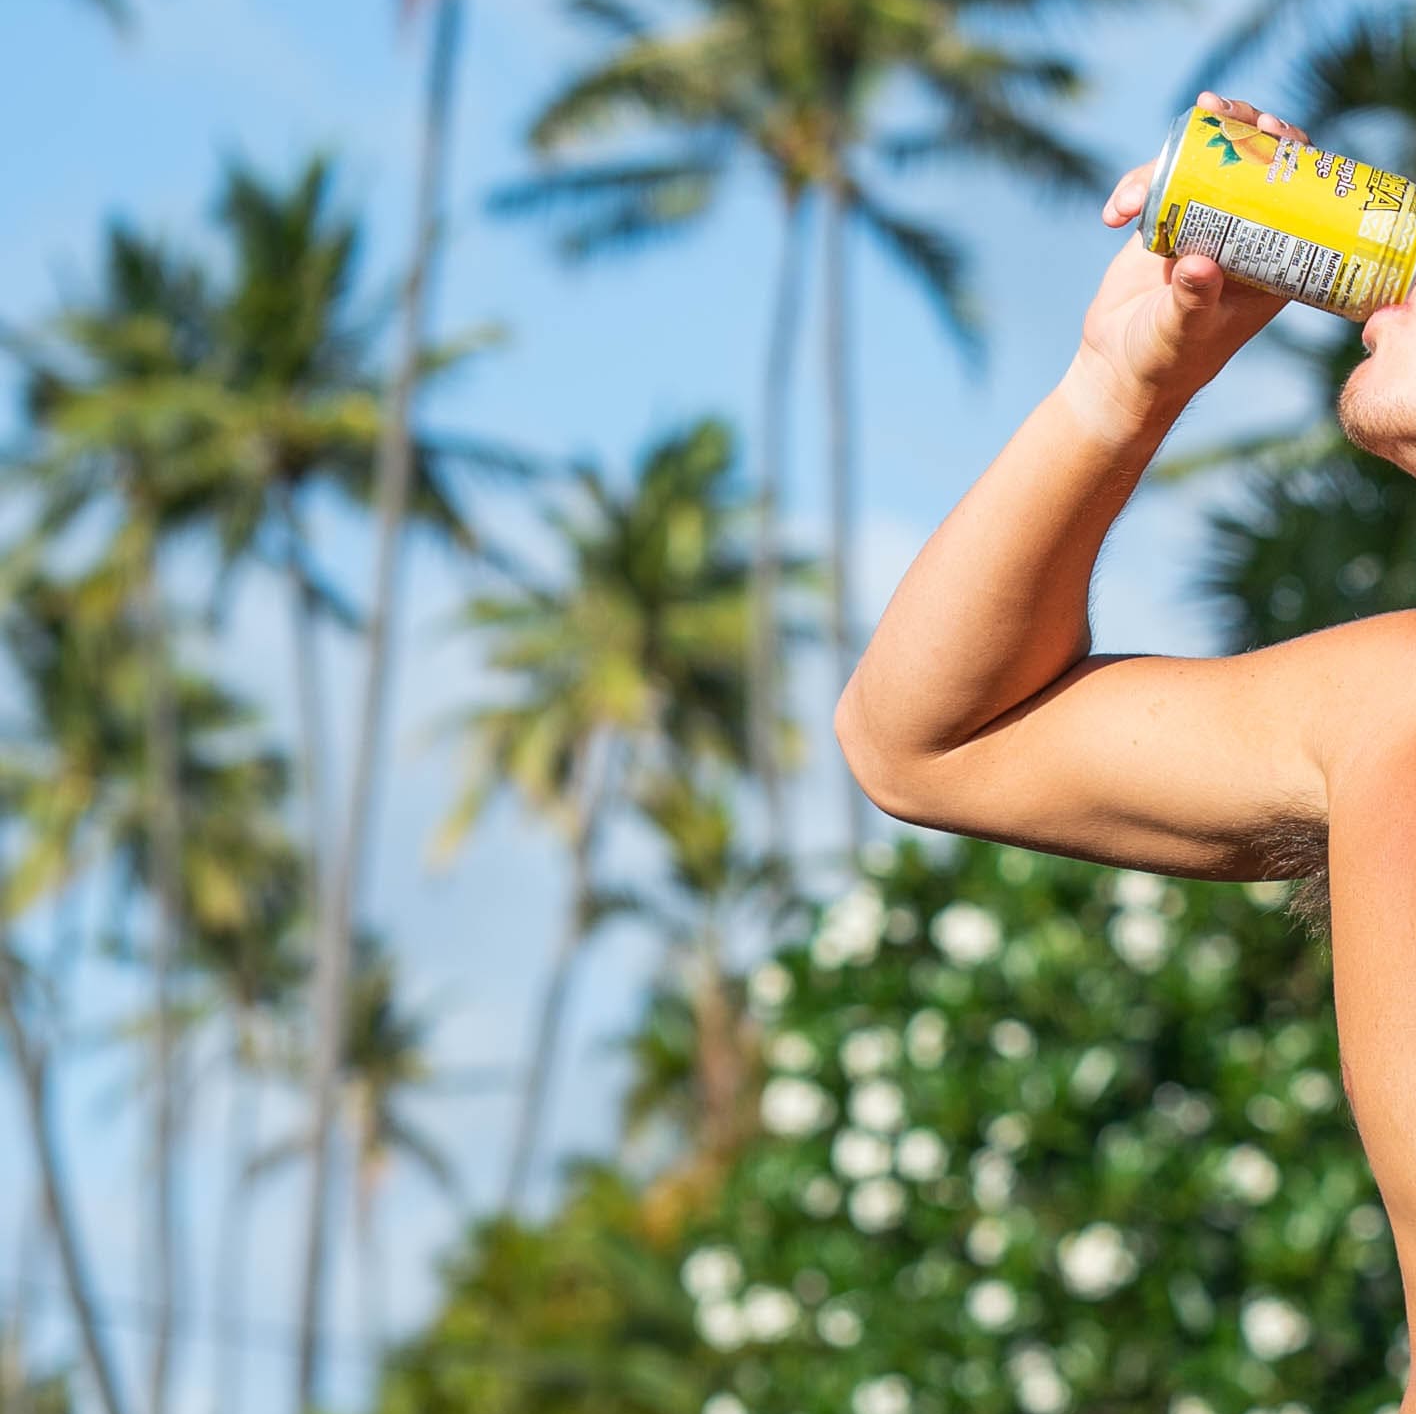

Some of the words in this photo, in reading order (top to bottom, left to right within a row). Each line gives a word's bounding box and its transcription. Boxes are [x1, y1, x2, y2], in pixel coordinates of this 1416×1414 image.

[1291, 240, 1308, 267] Calories
[1312, 248, 1328, 272] Serving
[1309, 272, 1320, 284] Size
[1320, 252, 1341, 289] Nutrition
